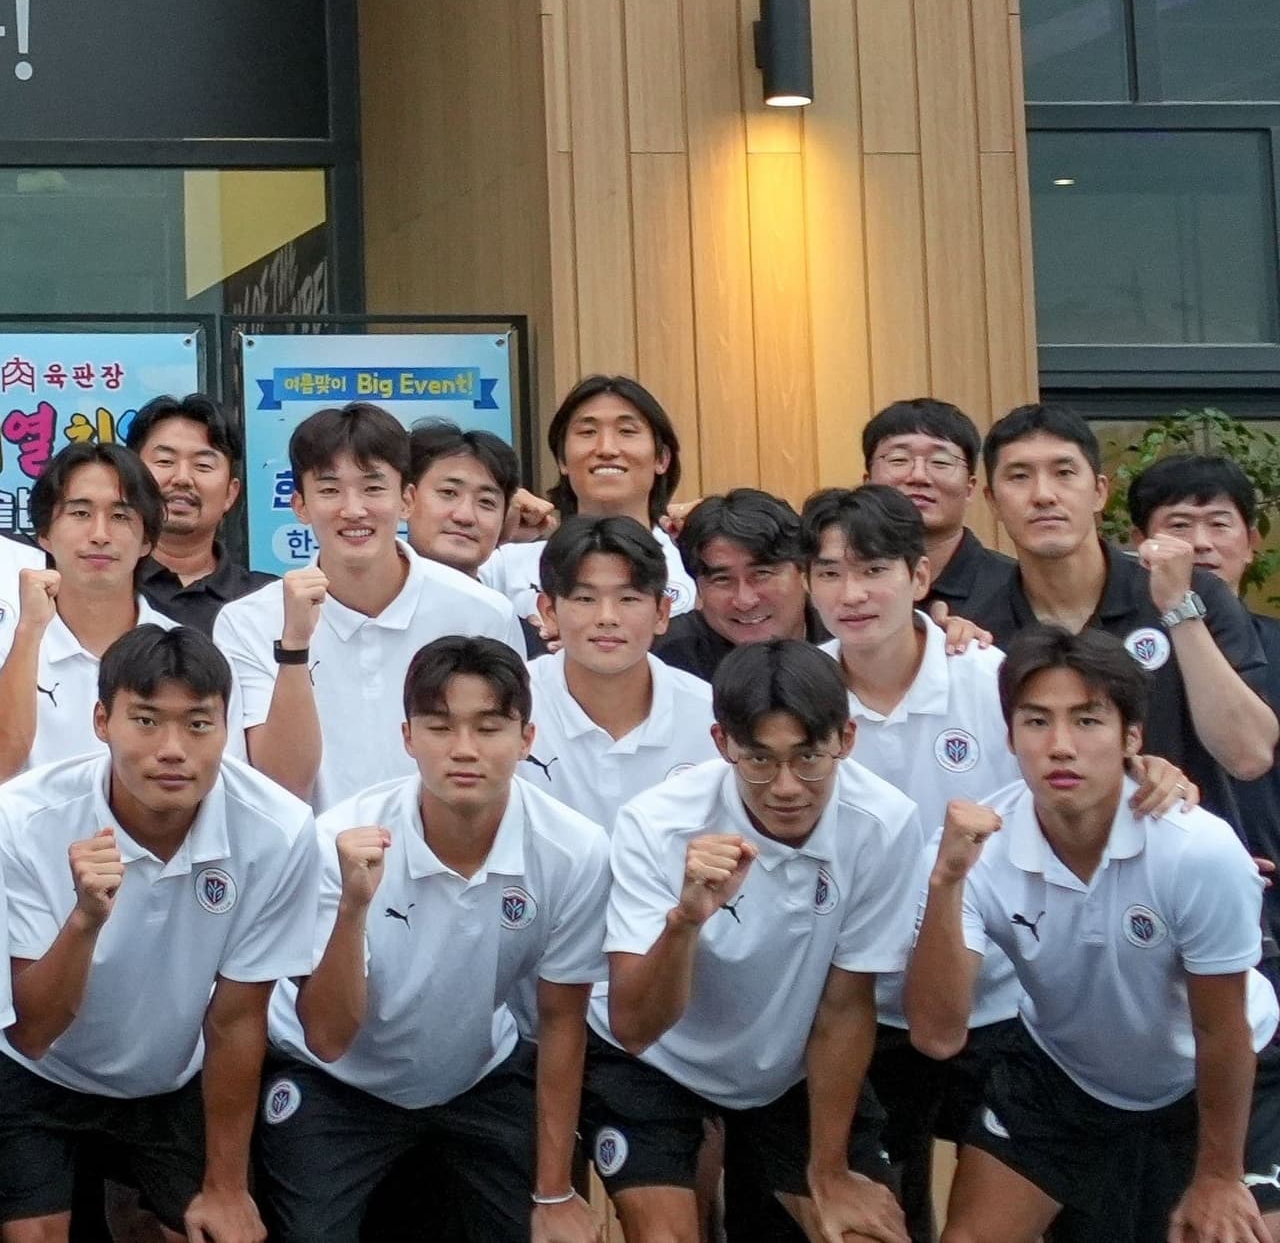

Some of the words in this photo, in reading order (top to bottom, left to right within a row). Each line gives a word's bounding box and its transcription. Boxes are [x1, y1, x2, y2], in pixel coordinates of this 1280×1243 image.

[42, 362, 125, 390] 육판장
[357, 371, 394, 399] Big
[399, 371, 474, 396] Event!
